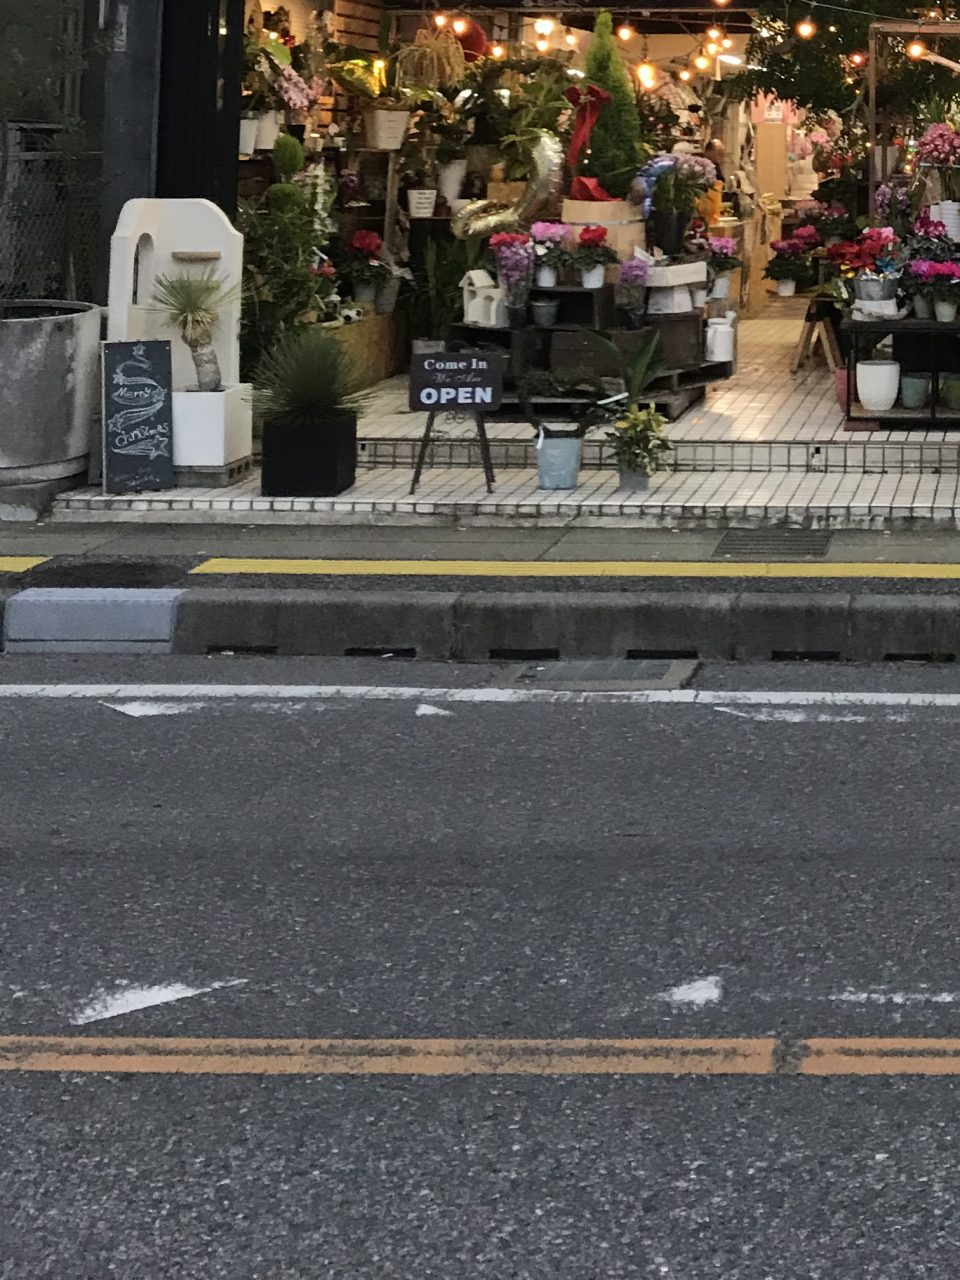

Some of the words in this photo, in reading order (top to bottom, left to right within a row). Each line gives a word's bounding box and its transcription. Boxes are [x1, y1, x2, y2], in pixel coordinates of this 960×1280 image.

[423, 359, 468, 370] Come
[471, 358, 488, 369] In
[118, 386, 152, 399] Merry
[420, 387, 493, 405] OPEN
